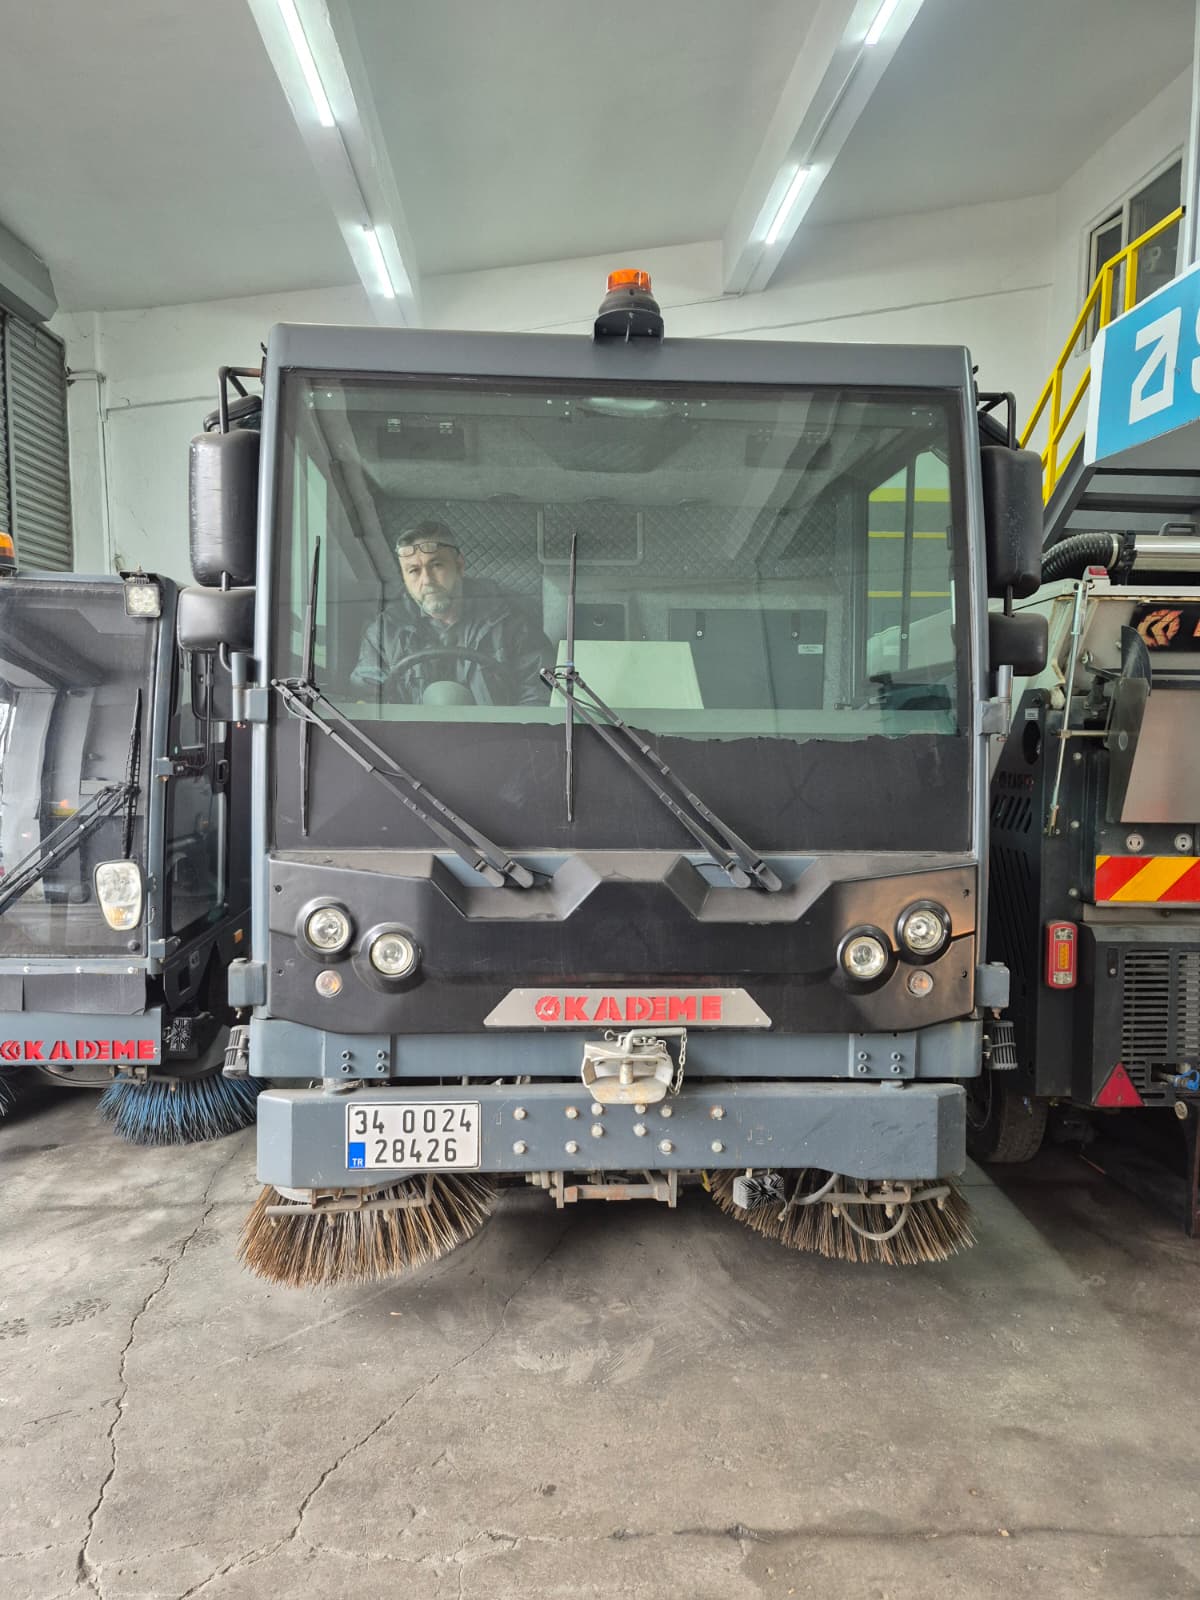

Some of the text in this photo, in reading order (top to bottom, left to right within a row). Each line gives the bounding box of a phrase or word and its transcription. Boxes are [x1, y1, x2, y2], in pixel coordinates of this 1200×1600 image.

[564, 995, 722, 1022] KADEME
[24, 1039, 156, 1061] KADEME
[354, 1109, 385, 1135] 34
[352, 1137, 457, 1167] TR 28426
